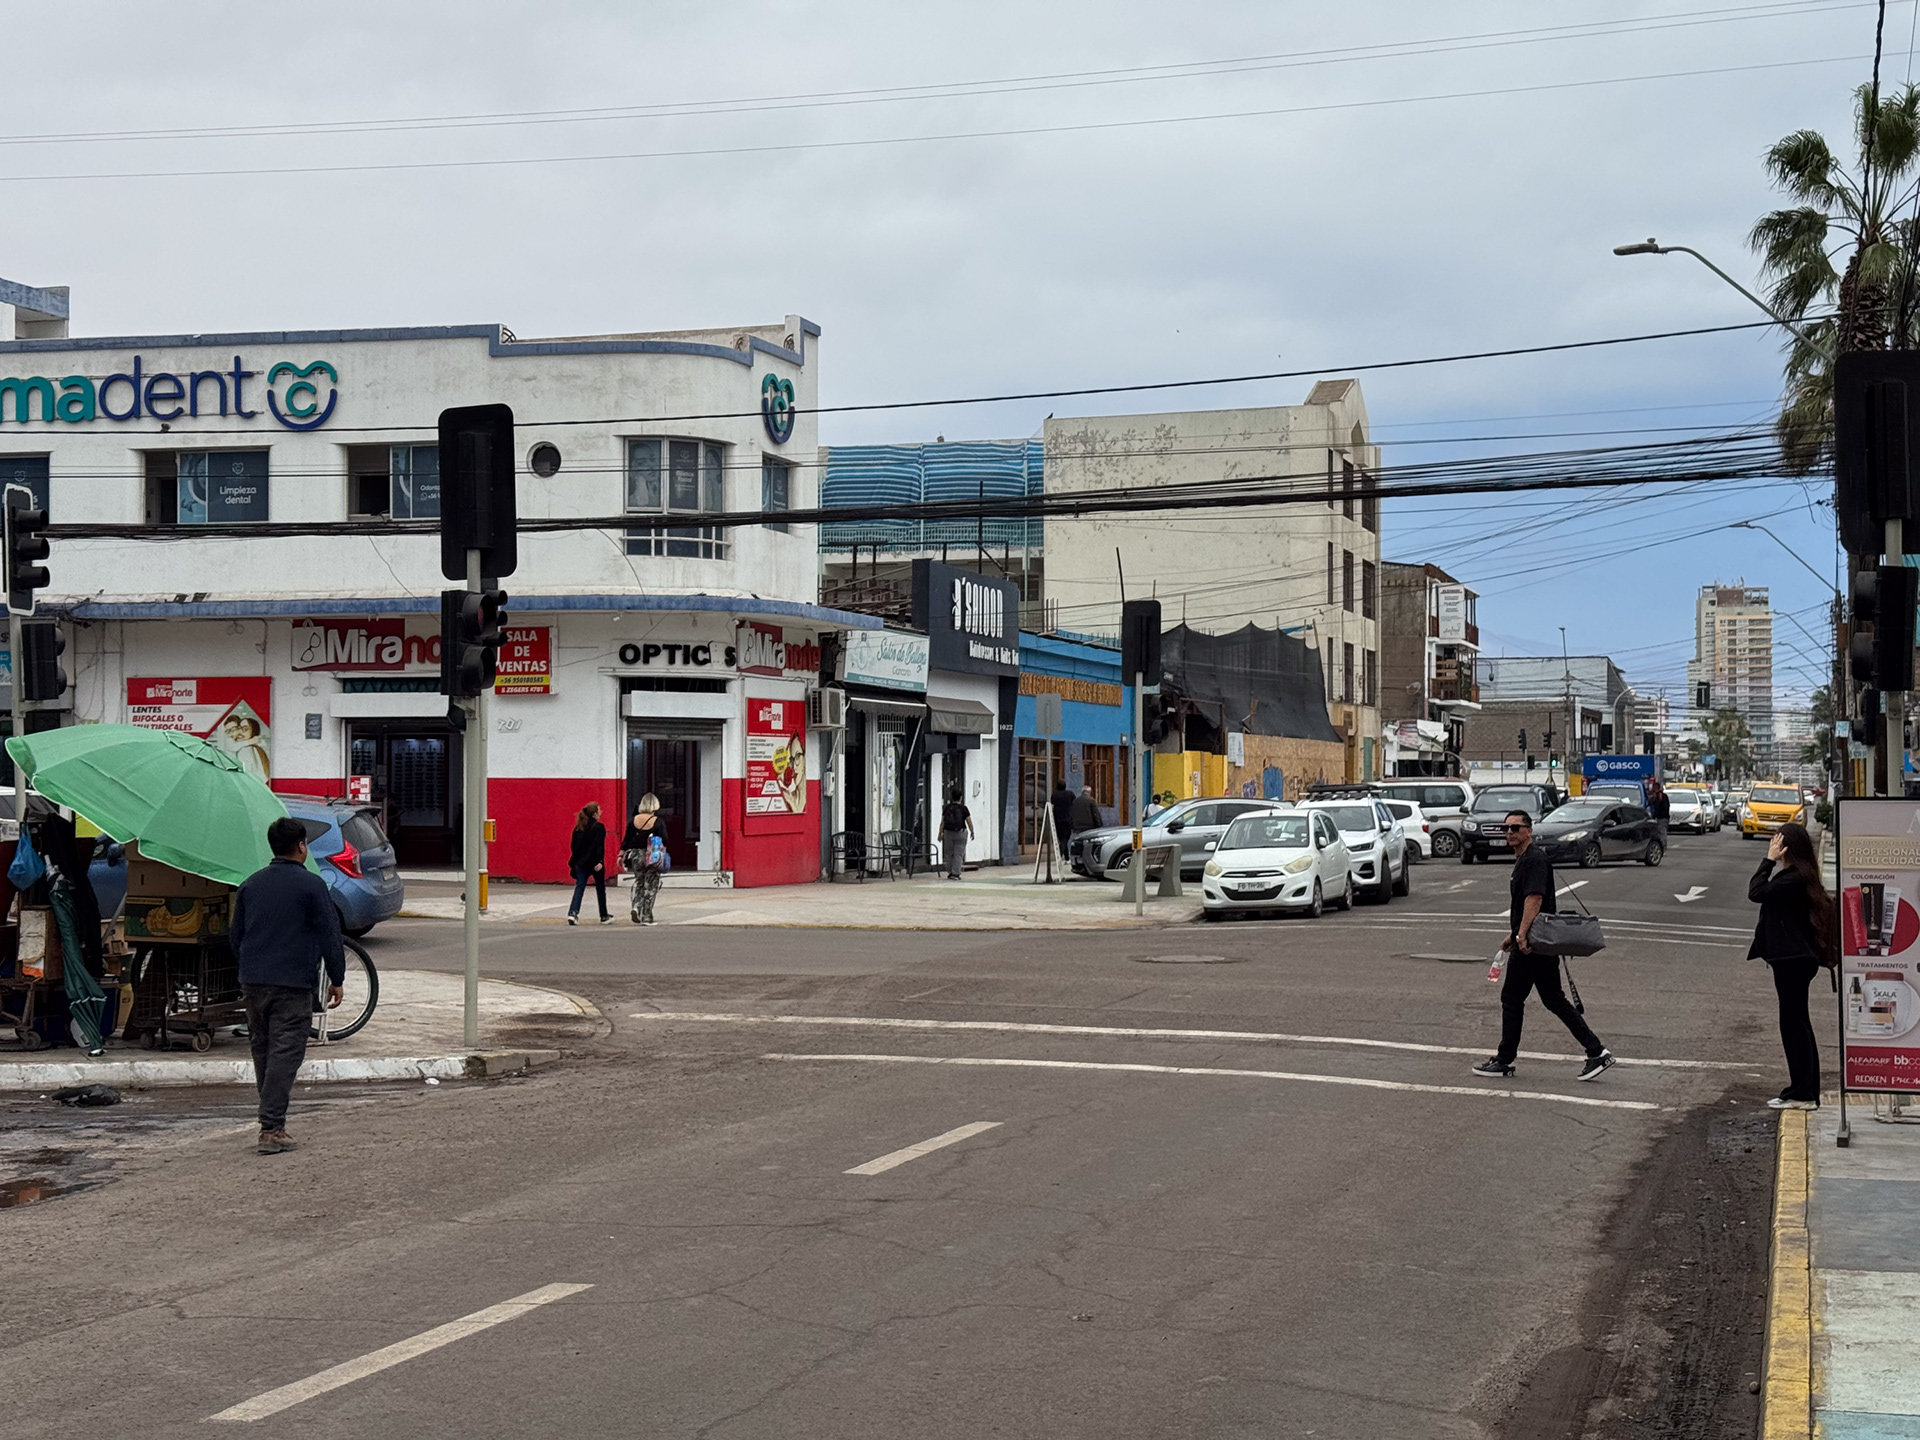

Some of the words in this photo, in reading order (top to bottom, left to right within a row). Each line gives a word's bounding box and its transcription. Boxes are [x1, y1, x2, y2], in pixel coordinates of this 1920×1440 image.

[219, 485, 257, 496] Limpieza
[225, 495, 251, 504] dental
[506, 630, 538, 642] SALA
[514, 645, 530, 657] DE
[498, 660, 547, 673] VENTAS
[132, 714, 176, 722] BIFOCALES
[1866, 857, 1879, 865] TU
[1855, 1074, 1887, 1084] REDKEN
